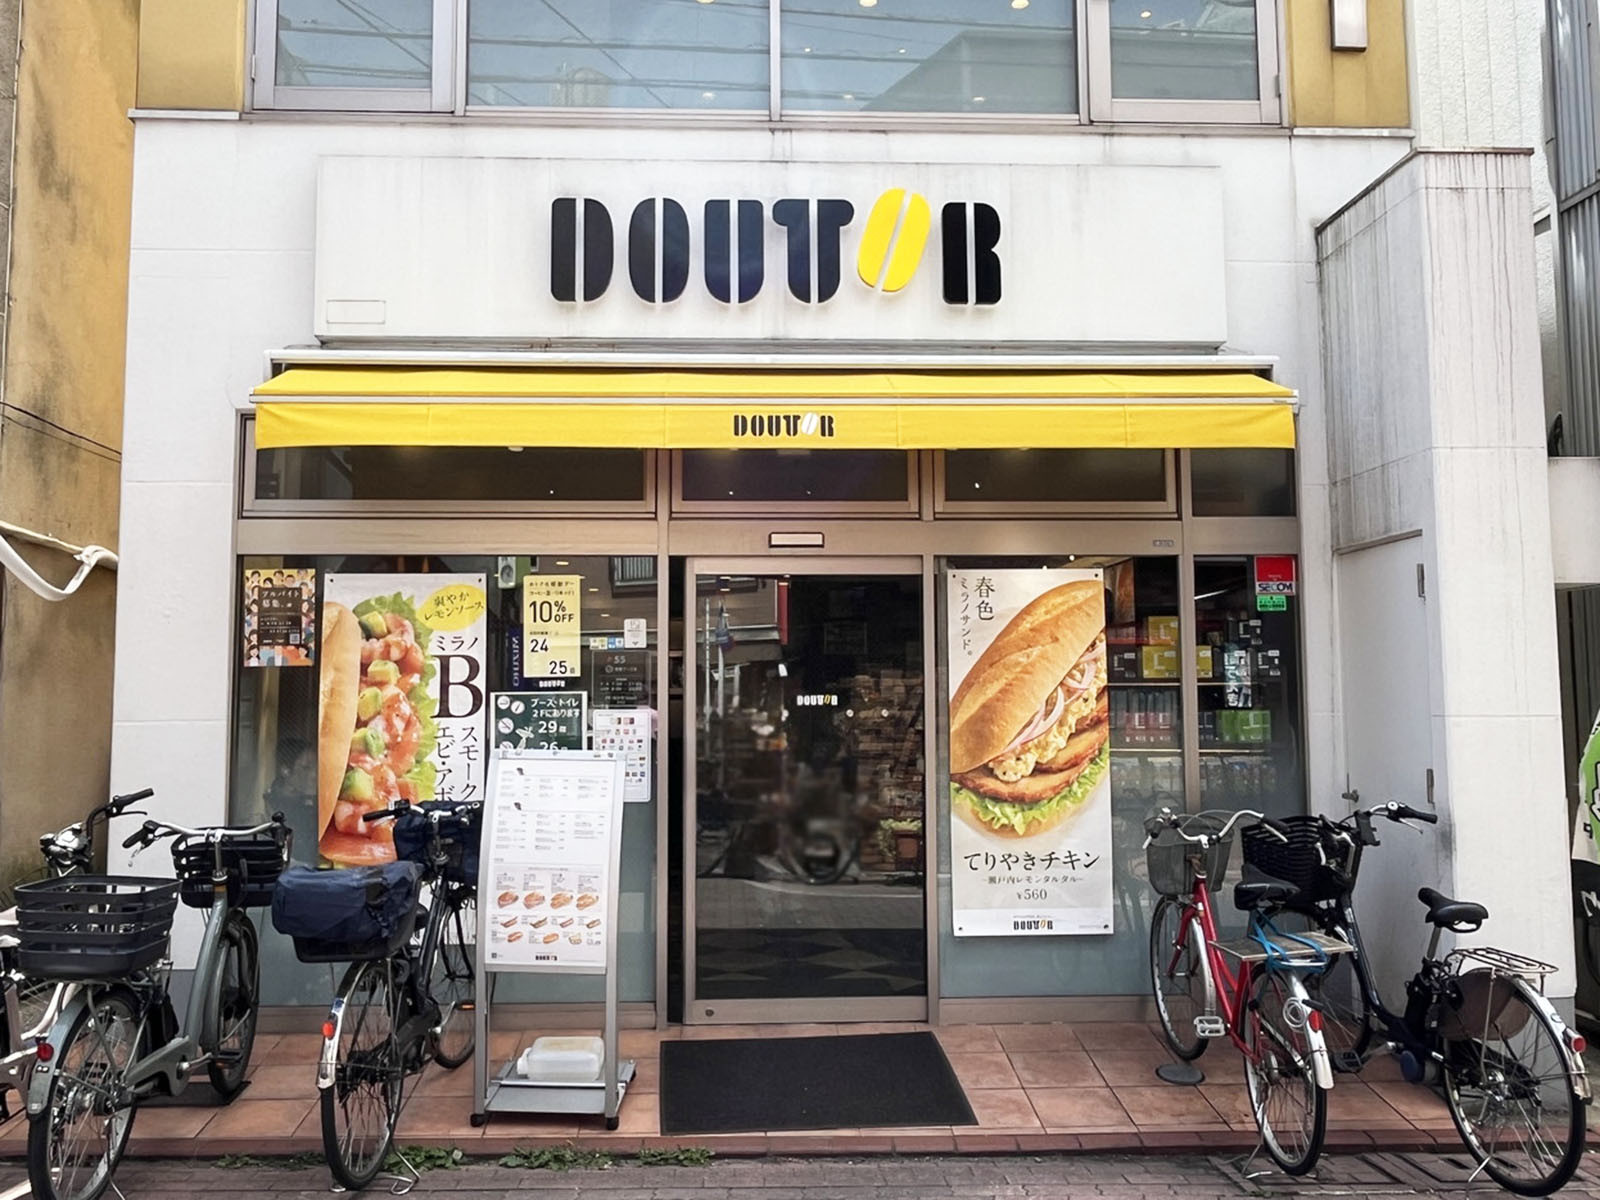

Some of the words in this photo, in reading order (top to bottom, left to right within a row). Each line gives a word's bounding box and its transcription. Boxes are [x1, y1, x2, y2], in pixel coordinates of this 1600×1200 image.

[550, 187, 1002, 305] DOUTOR
[733, 412, 835, 438] DOUTOR
[1258, 582, 1293, 592] SECOM
[433, 591, 471, 608] 爽やか
[974, 576, 996, 621] 春色
[423, 601, 484, 621] レモンソース
[554, 613, 575, 623] OFF
[435, 635, 480, 652] ミラノ
[530, 638, 549, 653] 24
[430, 654, 484, 719] B
[796, 694, 838, 706] DOUTOR
[964, 850, 1101, 872] てりやきチキン
[1016, 888, 1048, 901] ¥560
